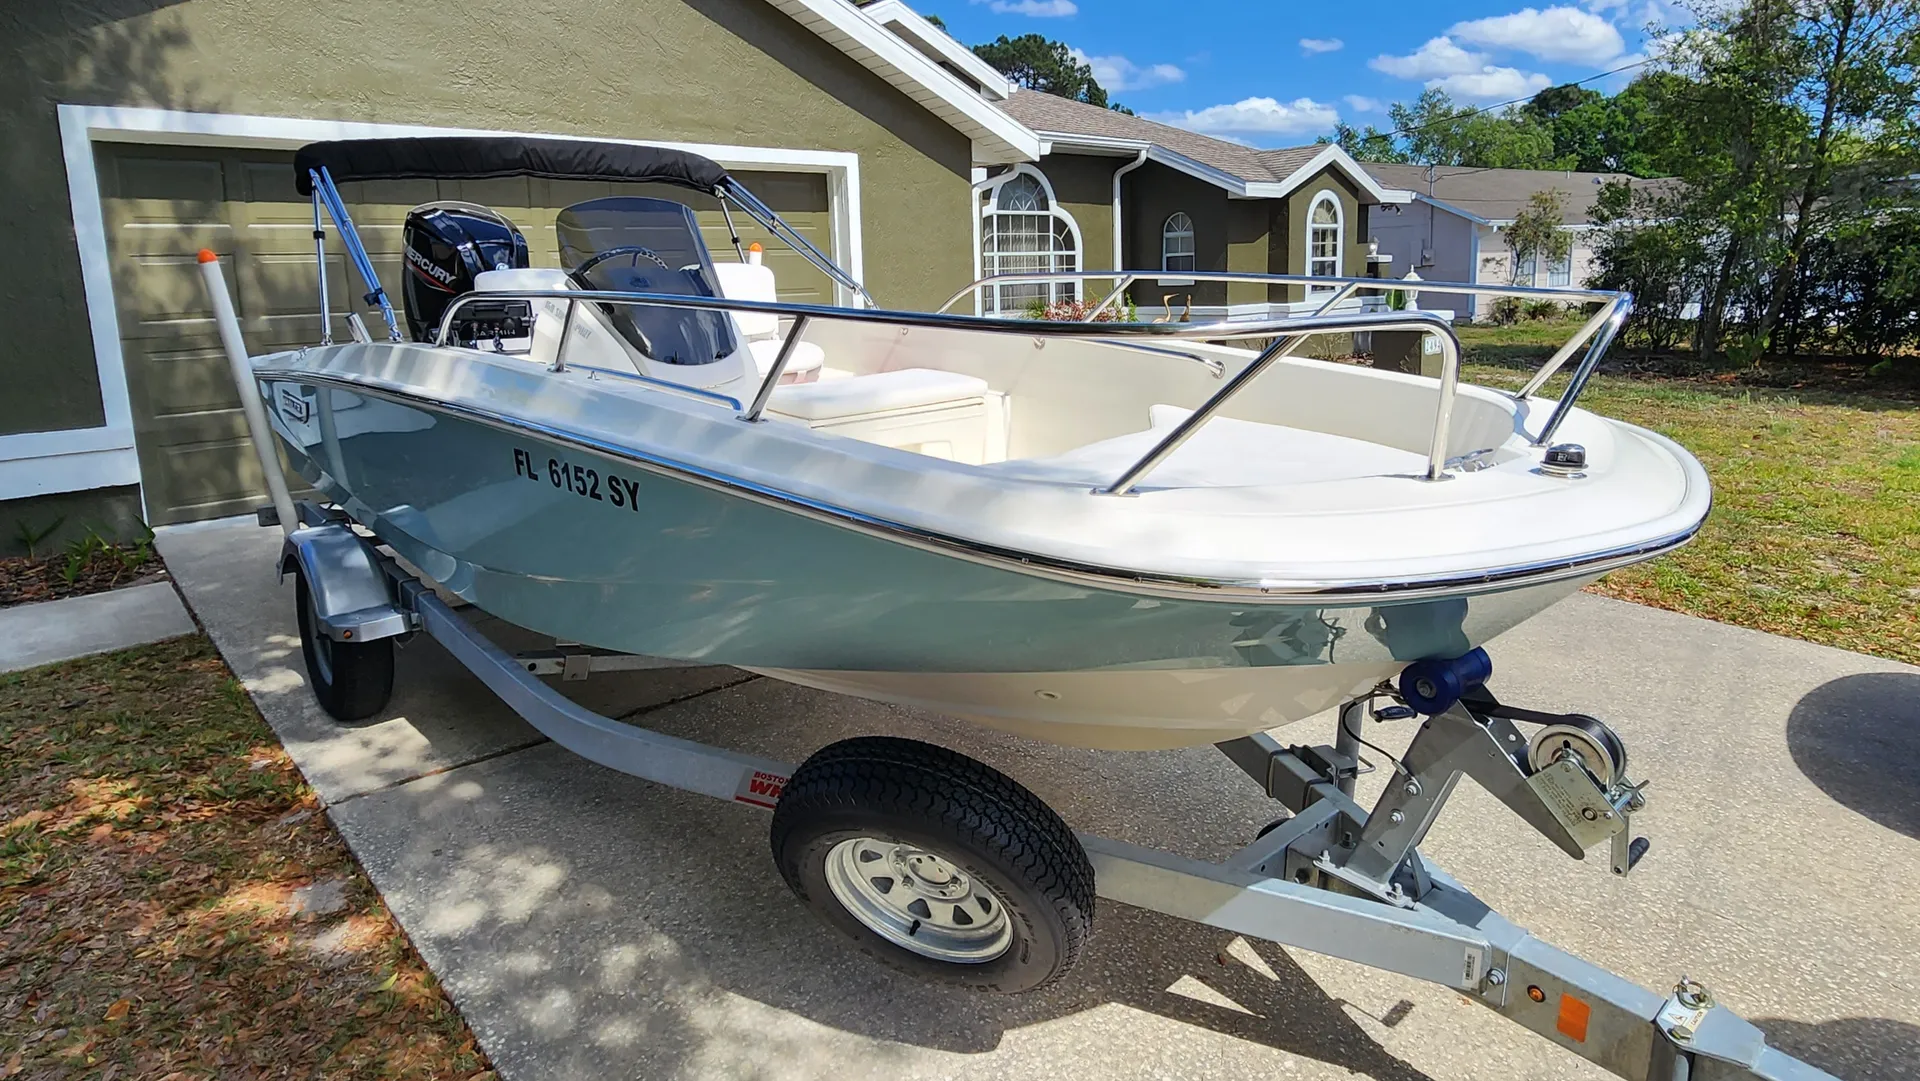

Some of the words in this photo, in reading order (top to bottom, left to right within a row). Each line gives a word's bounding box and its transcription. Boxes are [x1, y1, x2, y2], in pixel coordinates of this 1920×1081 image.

[405, 245, 457, 284] MERCURY
[513, 448, 538, 481] FL
[548, 458, 602, 501] 6152
[607, 475, 640, 512] SY
